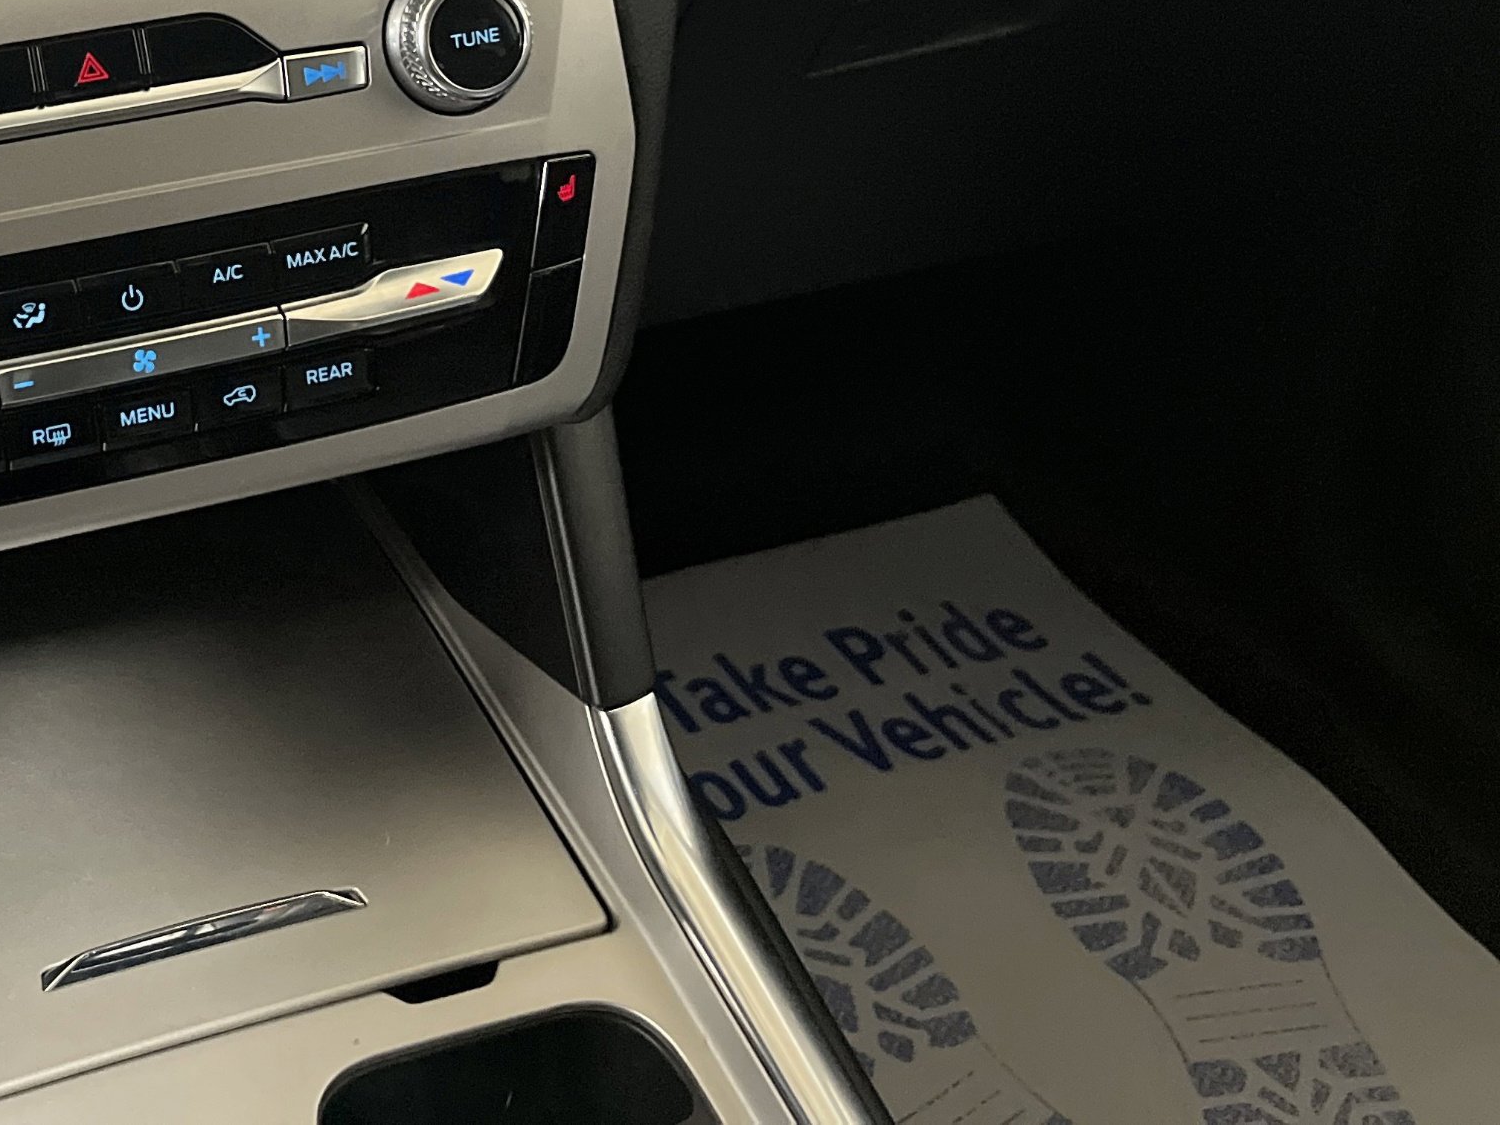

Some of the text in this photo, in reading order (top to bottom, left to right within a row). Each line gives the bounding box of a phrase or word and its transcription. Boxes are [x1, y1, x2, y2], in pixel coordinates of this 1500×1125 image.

[450, 27, 500, 49] TUNE
[286, 241, 359, 269] MAX A/C
[213, 264, 244, 284] A/C
[306, 362, 353, 385] REAR
[120, 402, 175, 427] MENU
[32, 429, 46, 445] R
[654, 599, 1050, 734] Take Pride
[687, 650, 1154, 822] our Vehicle!
